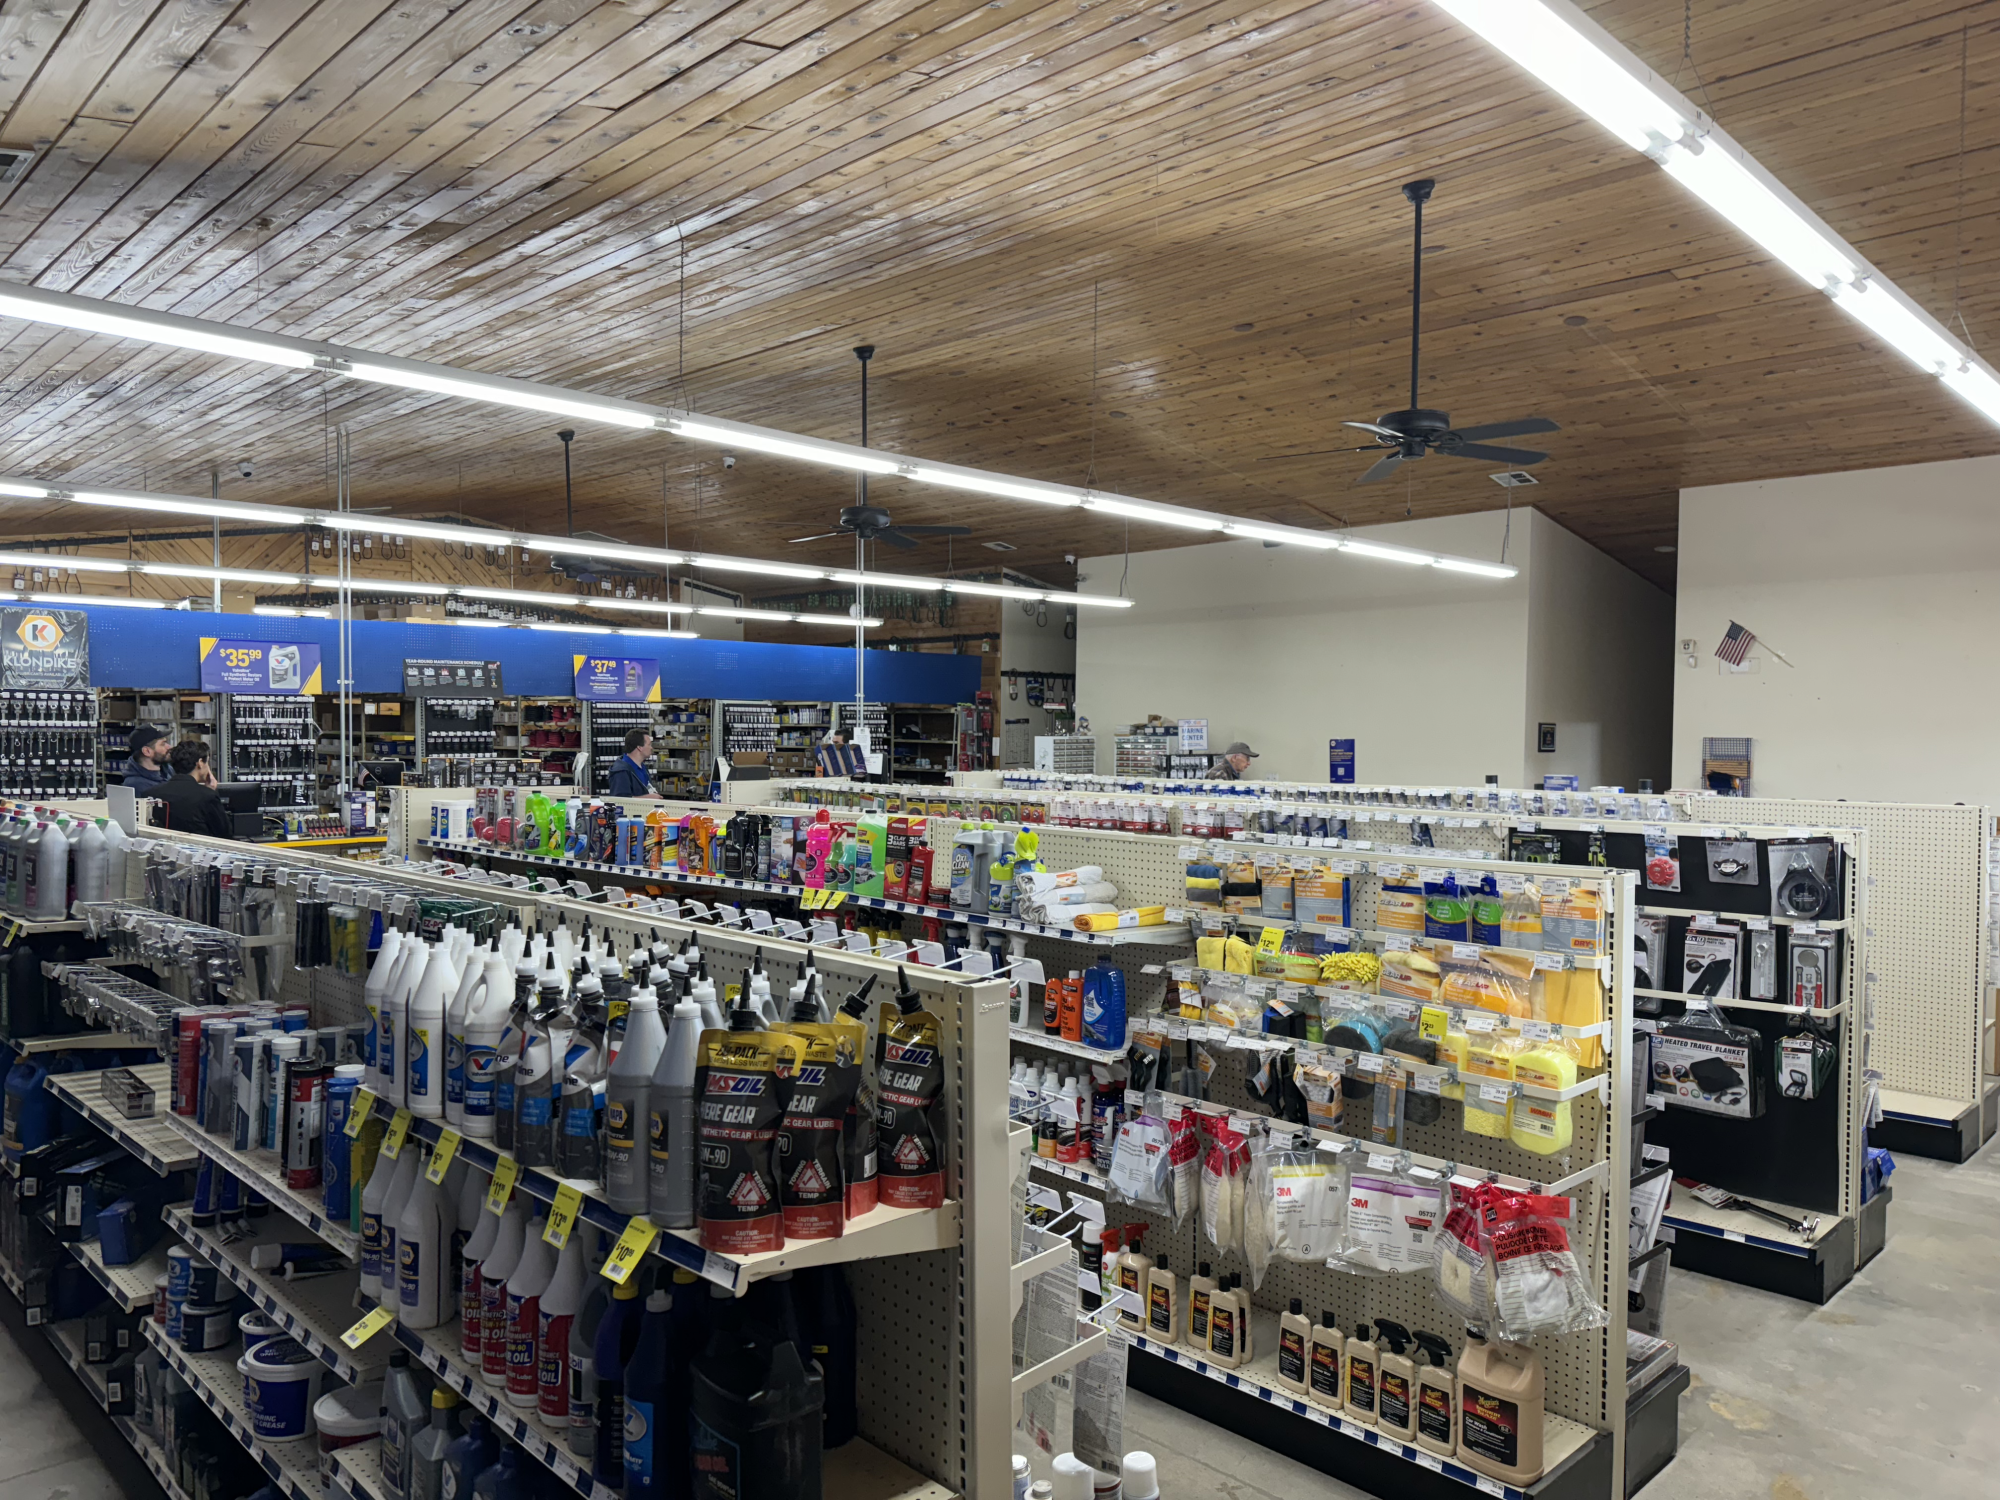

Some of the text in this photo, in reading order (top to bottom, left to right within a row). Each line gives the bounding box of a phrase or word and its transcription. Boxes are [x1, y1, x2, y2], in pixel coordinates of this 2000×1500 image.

[4, 655, 77, 668] KLONDIKE
[887, 834, 893, 843] 3
[956, 853, 967, 862] OXI
[953, 860, 970, 869] CLEAN
[1574, 939, 1590, 947] DRY
[1382, 969, 1412, 981] GEARUP
[1665, 1038, 1746, 1056] HEATED TRAVEL BLANKET
[886, 1042, 933, 1067] MSOIL
[707, 1073, 767, 1095] MSOIL
[893, 1072, 923, 1092] GEAR
[898, 1096, 915, 1105] GEAR
[723, 1105, 757, 1125] GEAR
[793, 1118, 835, 1128] GEAR LUBE
[730, 1130, 752, 1140] GEAR
[754, 1131, 775, 1140] LUBE
[1121, 1127, 1130, 1138] 3M
[892, 1134, 930, 1161] TOWING TERRAIN
[788, 1158, 832, 1190] TOWING TERRAIN
[726, 1170, 772, 1201] TOWING TERRAIN
[1276, 1187, 1292, 1197] 3M
[1351, 1197, 1368, 1209] 3M
[1418, 1210, 1437, 1218] 05737
[364, 1222, 376, 1232] NAPA
[615, 1242, 635, 1262] $1099
[513, 1352, 530, 1362] OIL
[516, 1371, 532, 1380] Lube
[542, 1372, 557, 1382] OIL
[260, 1421, 287, 1429] GREASE
[1473, 1420, 1488, 1430] Wash
